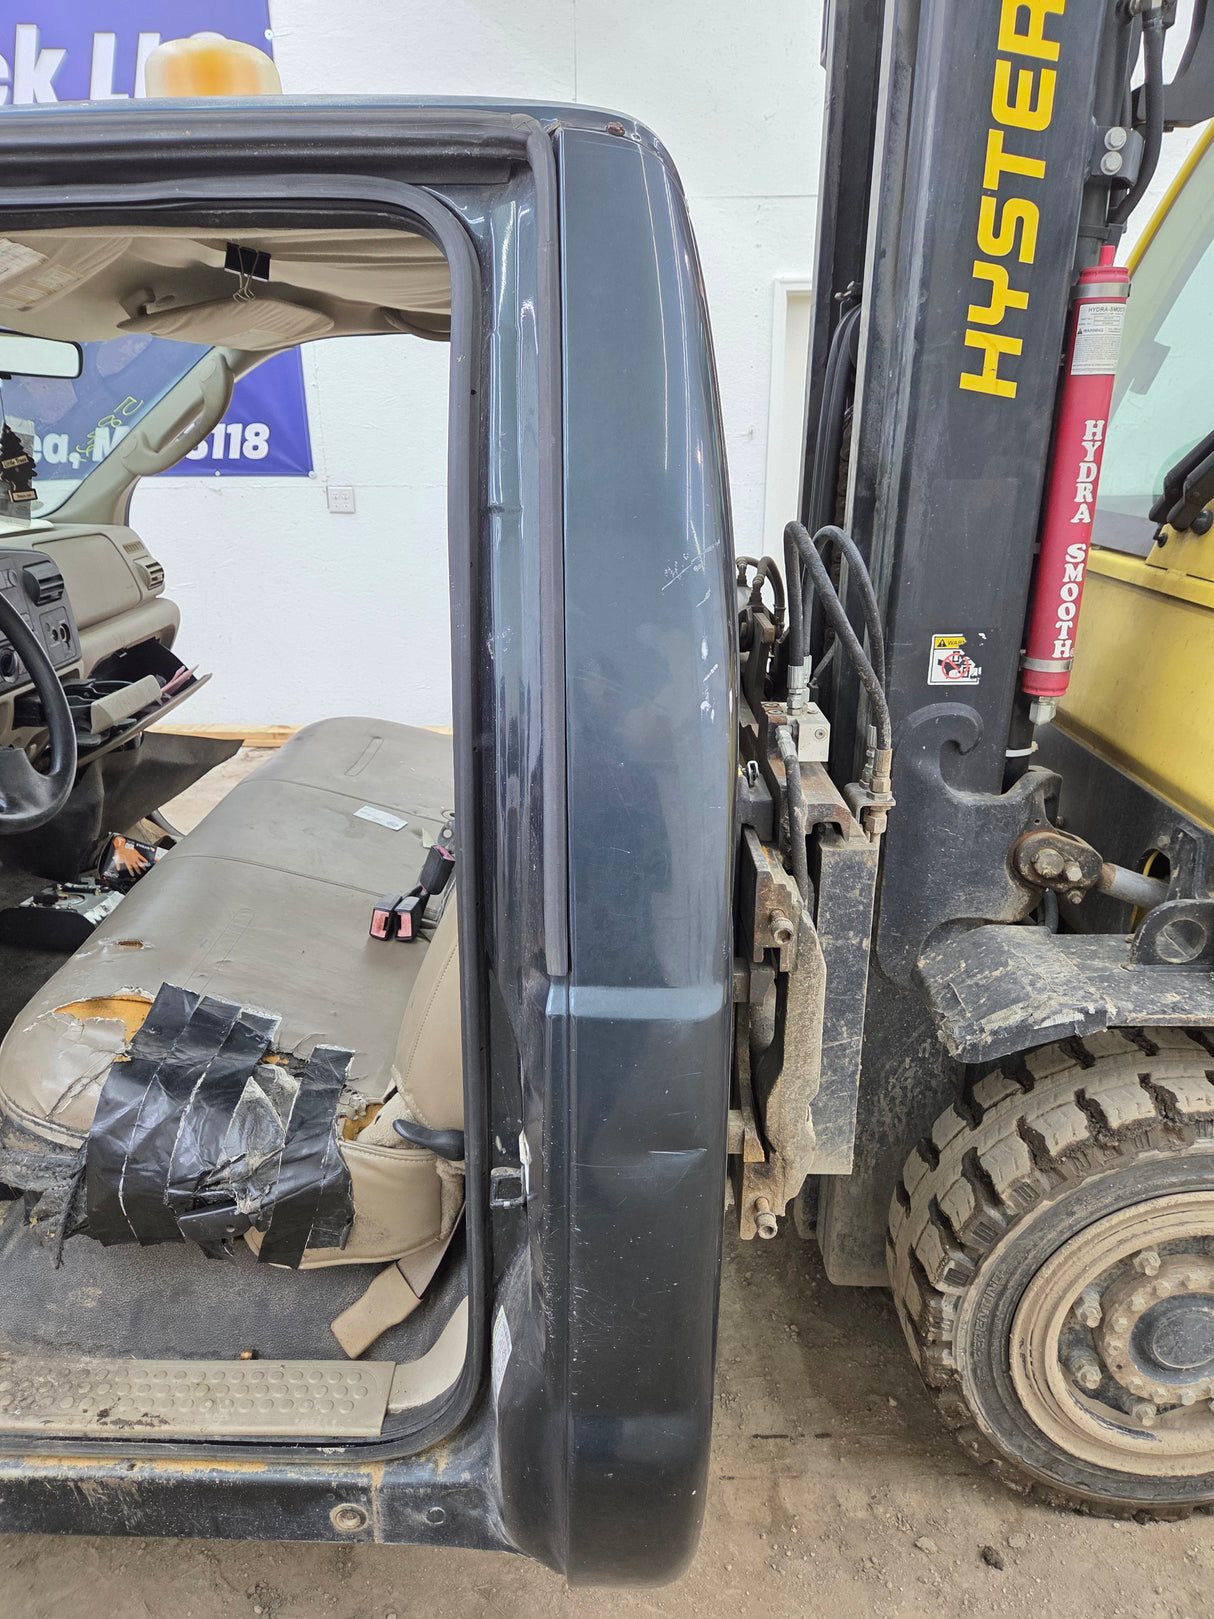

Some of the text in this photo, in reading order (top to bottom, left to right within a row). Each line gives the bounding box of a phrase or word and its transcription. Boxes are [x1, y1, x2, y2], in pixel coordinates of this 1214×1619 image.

[959, 0, 1067, 399] HYSTER
[1051, 419, 1105, 658] HYDRA SMOOTH
